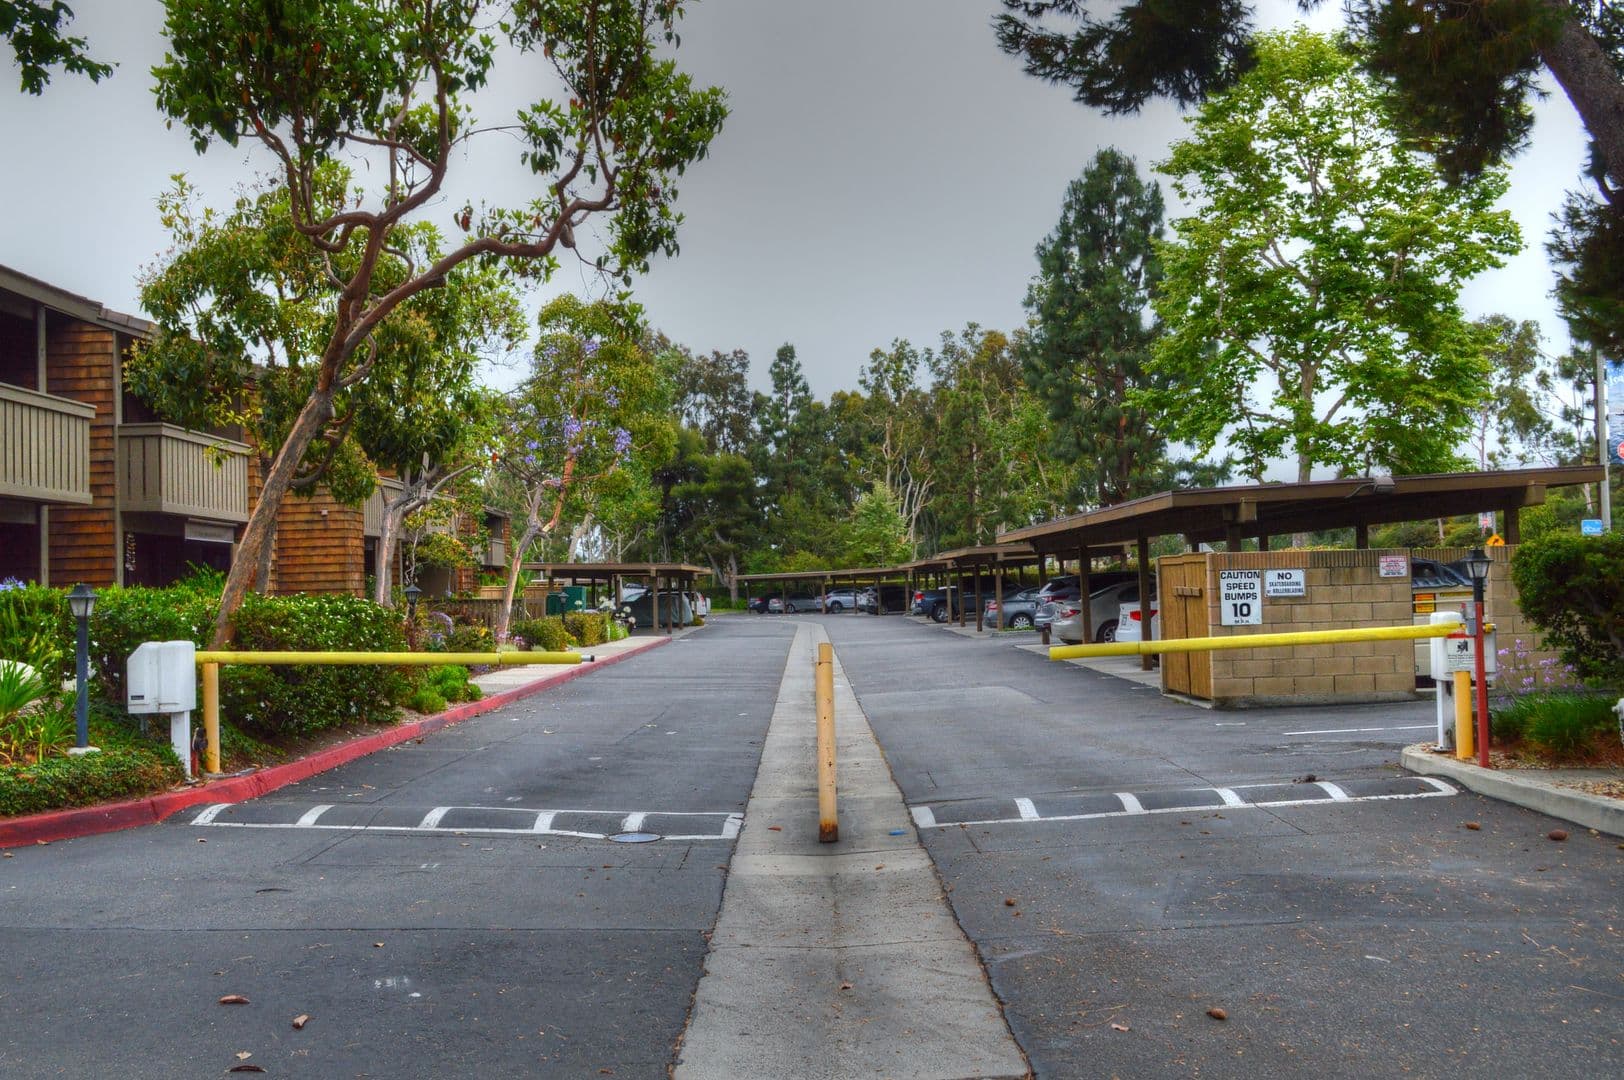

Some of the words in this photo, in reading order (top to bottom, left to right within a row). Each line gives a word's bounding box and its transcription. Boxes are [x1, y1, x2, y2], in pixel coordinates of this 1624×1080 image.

[1220, 571, 1260, 580] CAUTION
[1277, 572, 1292, 580] NO
[1226, 582, 1255, 590] SPEED
[1224, 592, 1257, 600] BUMPS
[1232, 603, 1251, 617] 10
